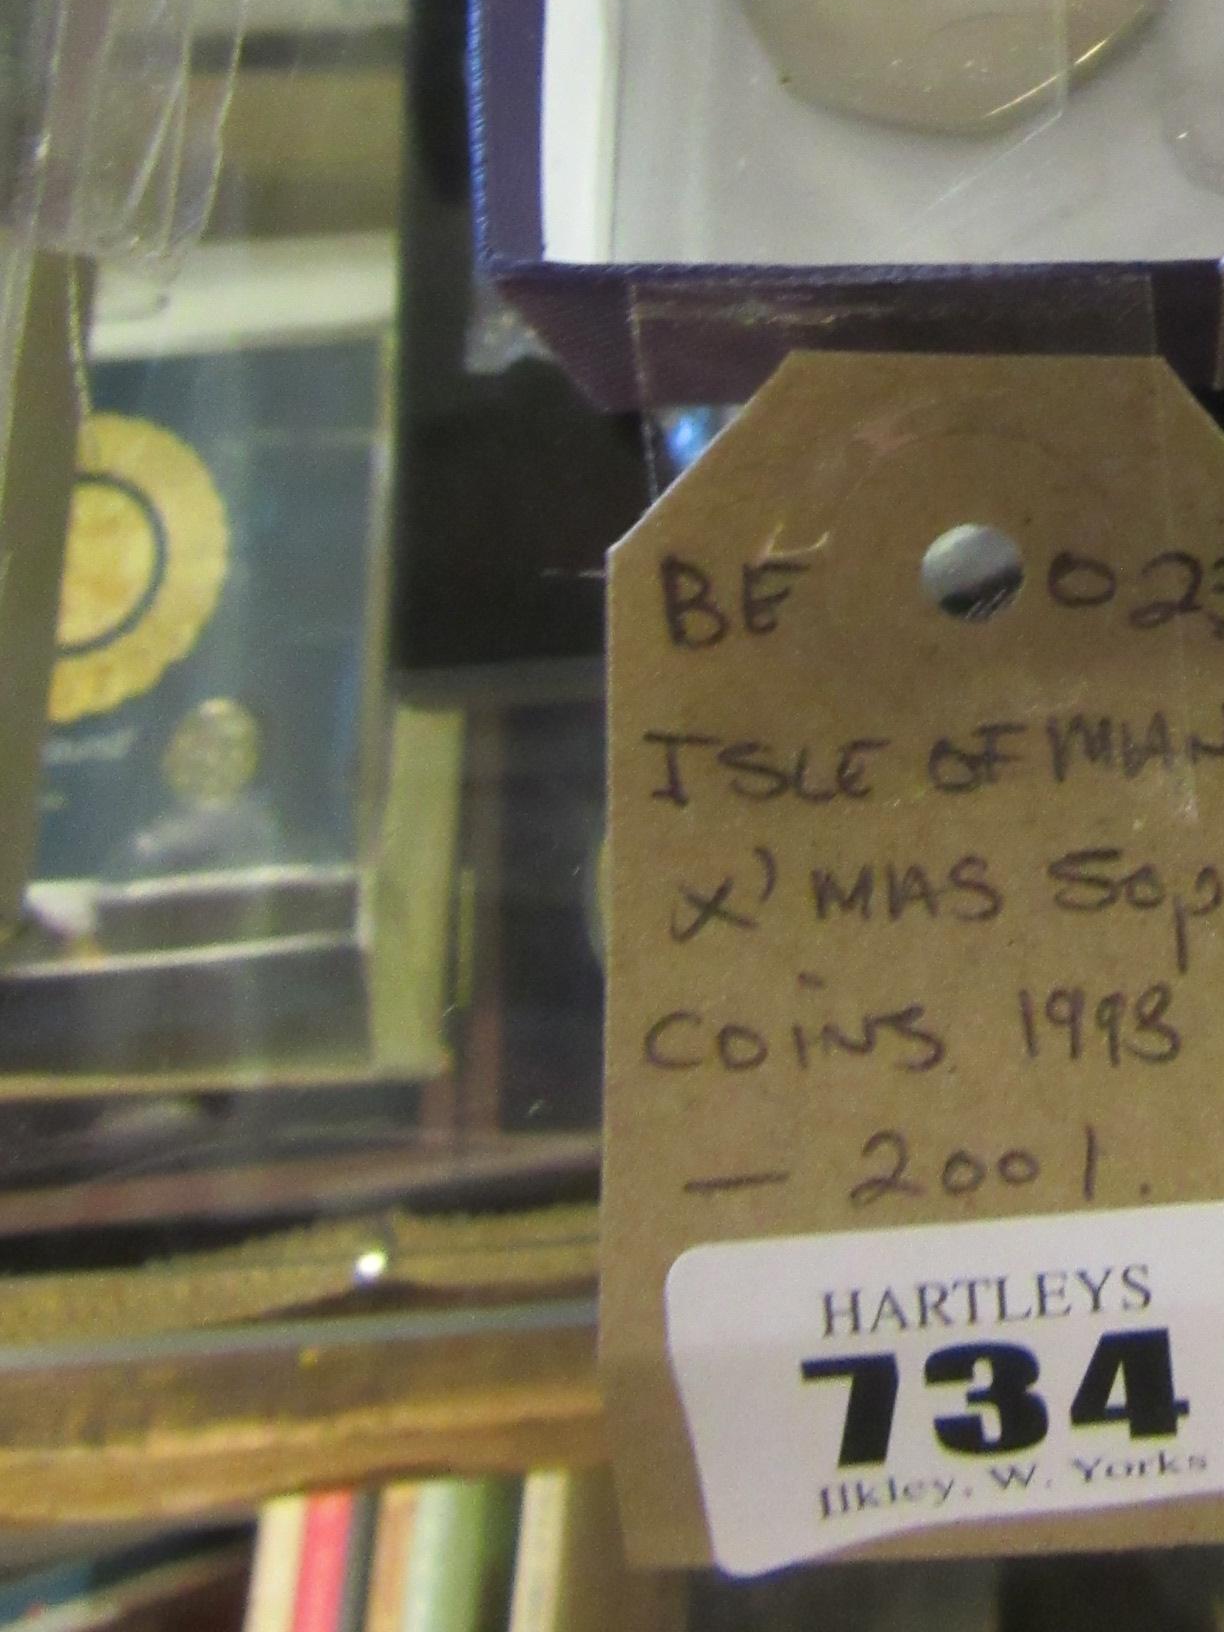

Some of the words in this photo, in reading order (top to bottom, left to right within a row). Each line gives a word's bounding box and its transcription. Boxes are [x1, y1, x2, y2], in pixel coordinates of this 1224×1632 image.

[642, 729, 892, 808] ISLE
[927, 722, 1029, 794] OF
[1017, 981, 1182, 1068] 1998
[818, 1263, 1153, 1339] HARTLEYS
[799, 1326, 1192, 1470] 734
[1071, 1449, 1210, 1485] Yorks
